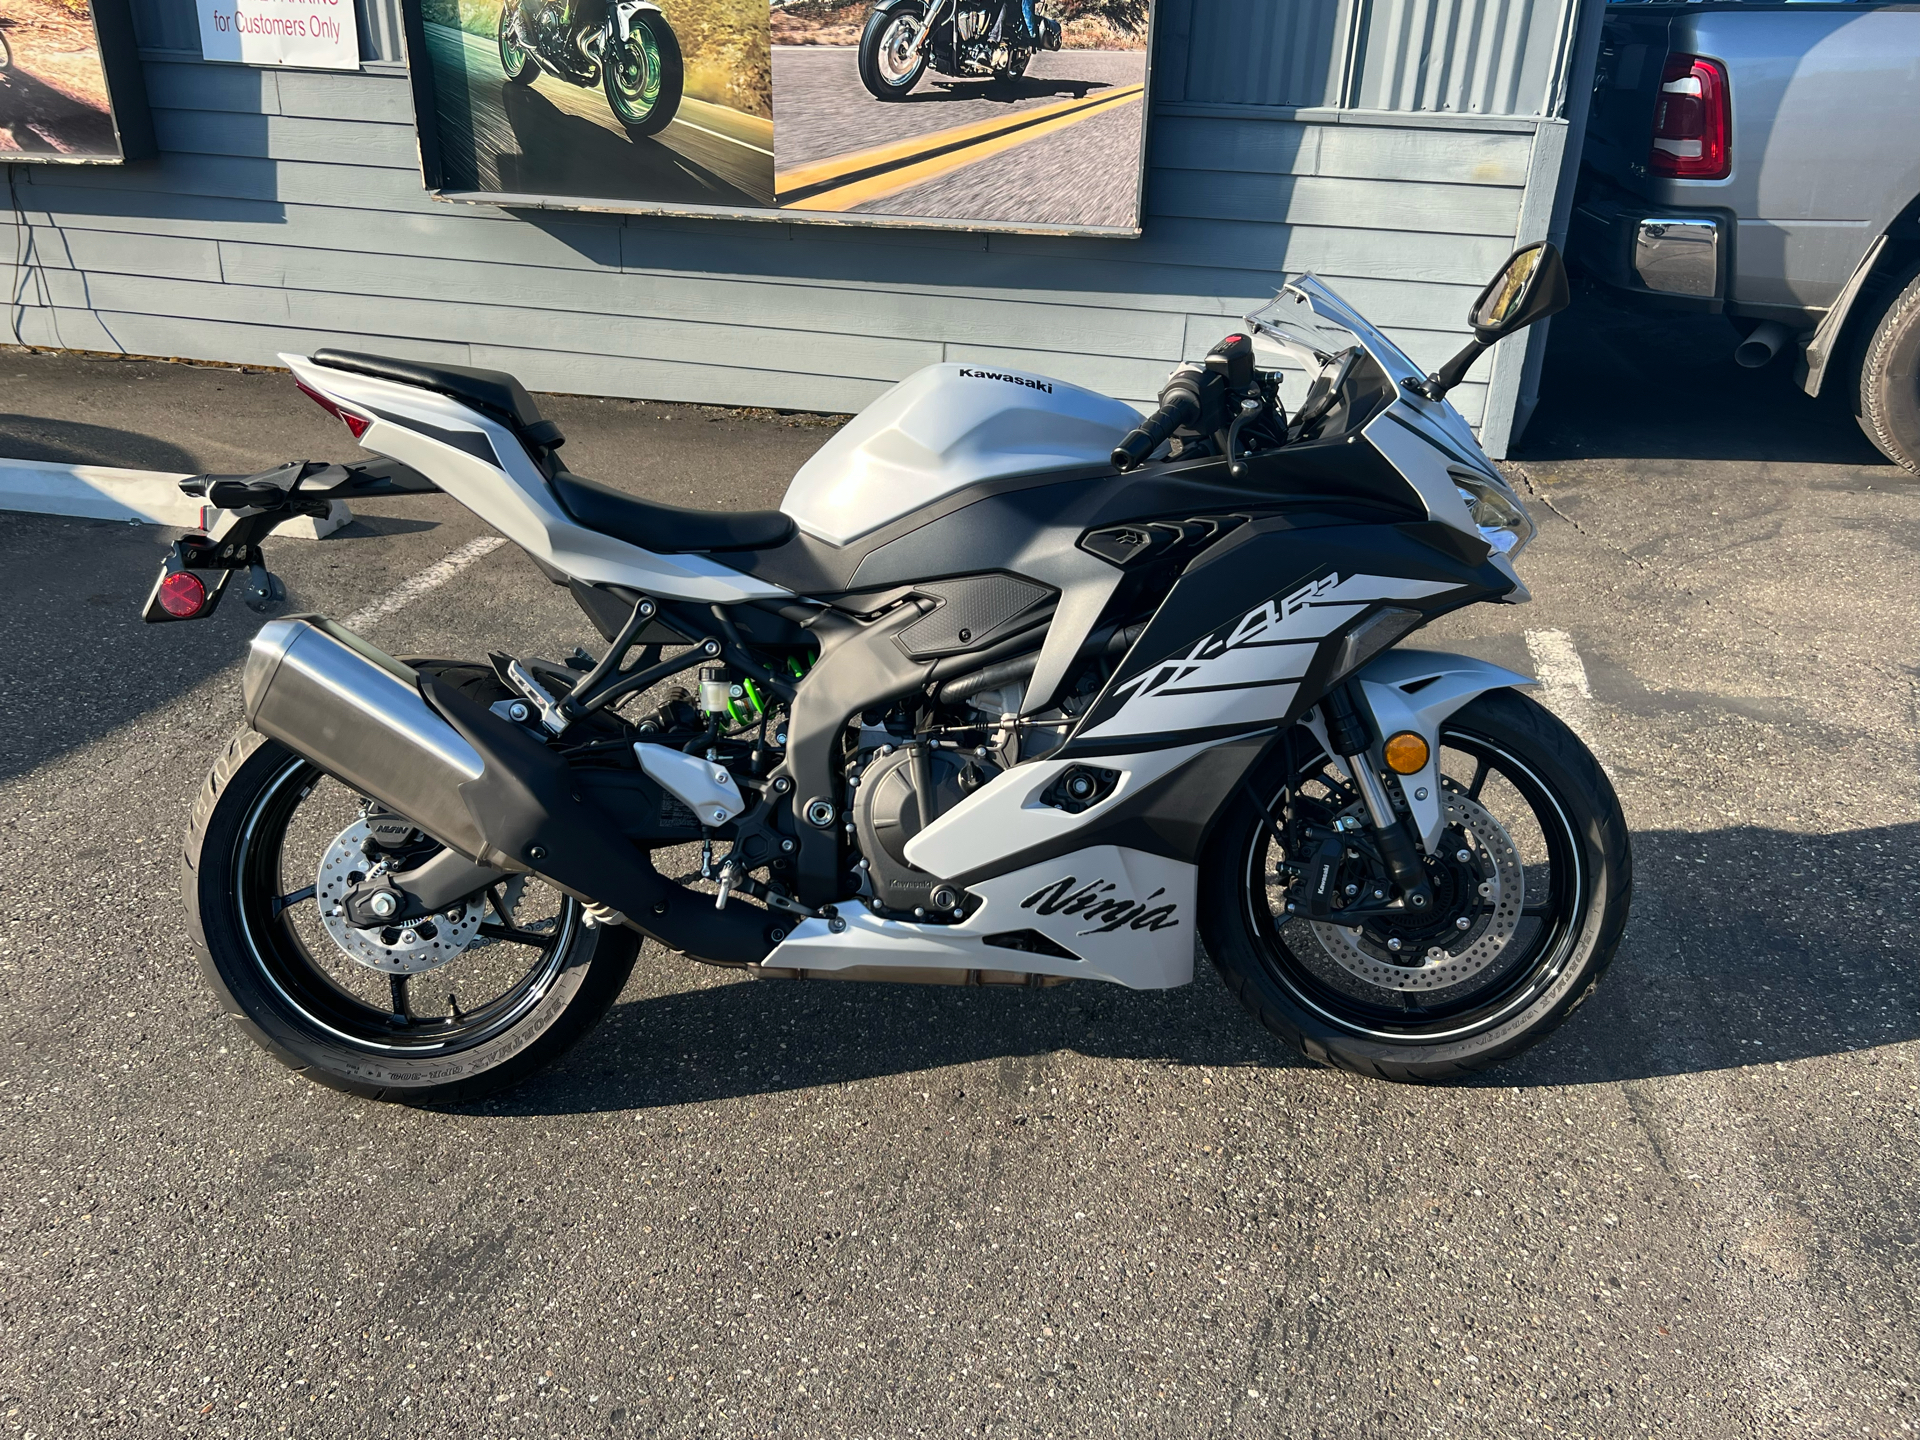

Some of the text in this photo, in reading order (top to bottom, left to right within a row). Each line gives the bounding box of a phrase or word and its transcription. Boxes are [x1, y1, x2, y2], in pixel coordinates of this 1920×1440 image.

[214, 10, 340, 44] for Customers Only
[959, 368, 1053, 395] Kawasaki
[890, 879, 933, 890] Kawasaki
[1317, 864, 1330, 895] Kawasaki
[1019, 875, 1179, 937] Ninja
[1539, 932, 1593, 1010] SPORTMAX
[470, 997, 564, 1069] SPORTMAX
